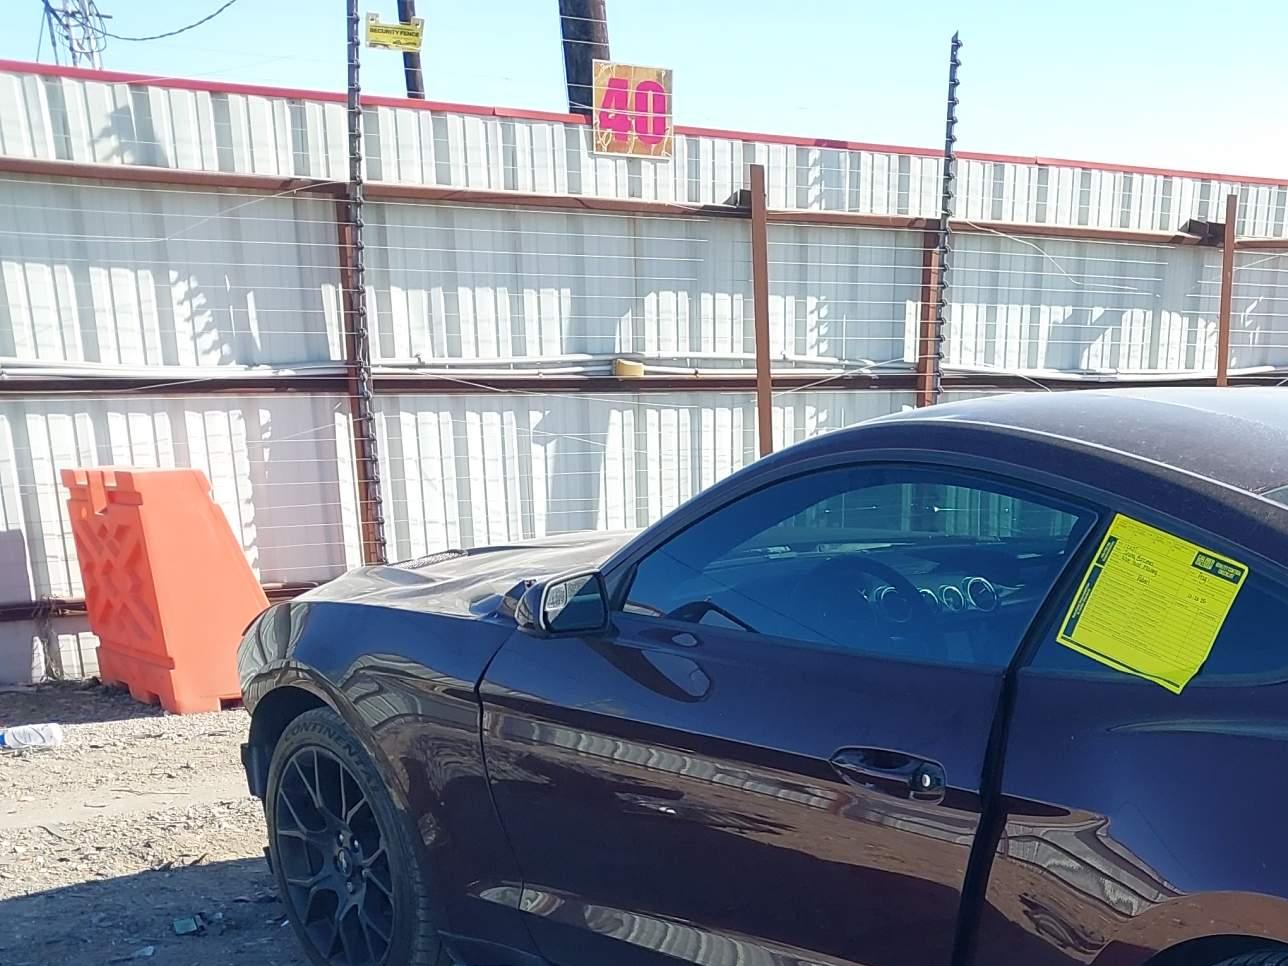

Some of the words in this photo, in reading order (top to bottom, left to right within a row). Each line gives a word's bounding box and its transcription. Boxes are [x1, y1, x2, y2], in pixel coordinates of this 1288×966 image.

[370, 27, 399, 35] SECURITY
[400, 30, 420, 38] FENCE
[599, 77, 666, 145] 40
